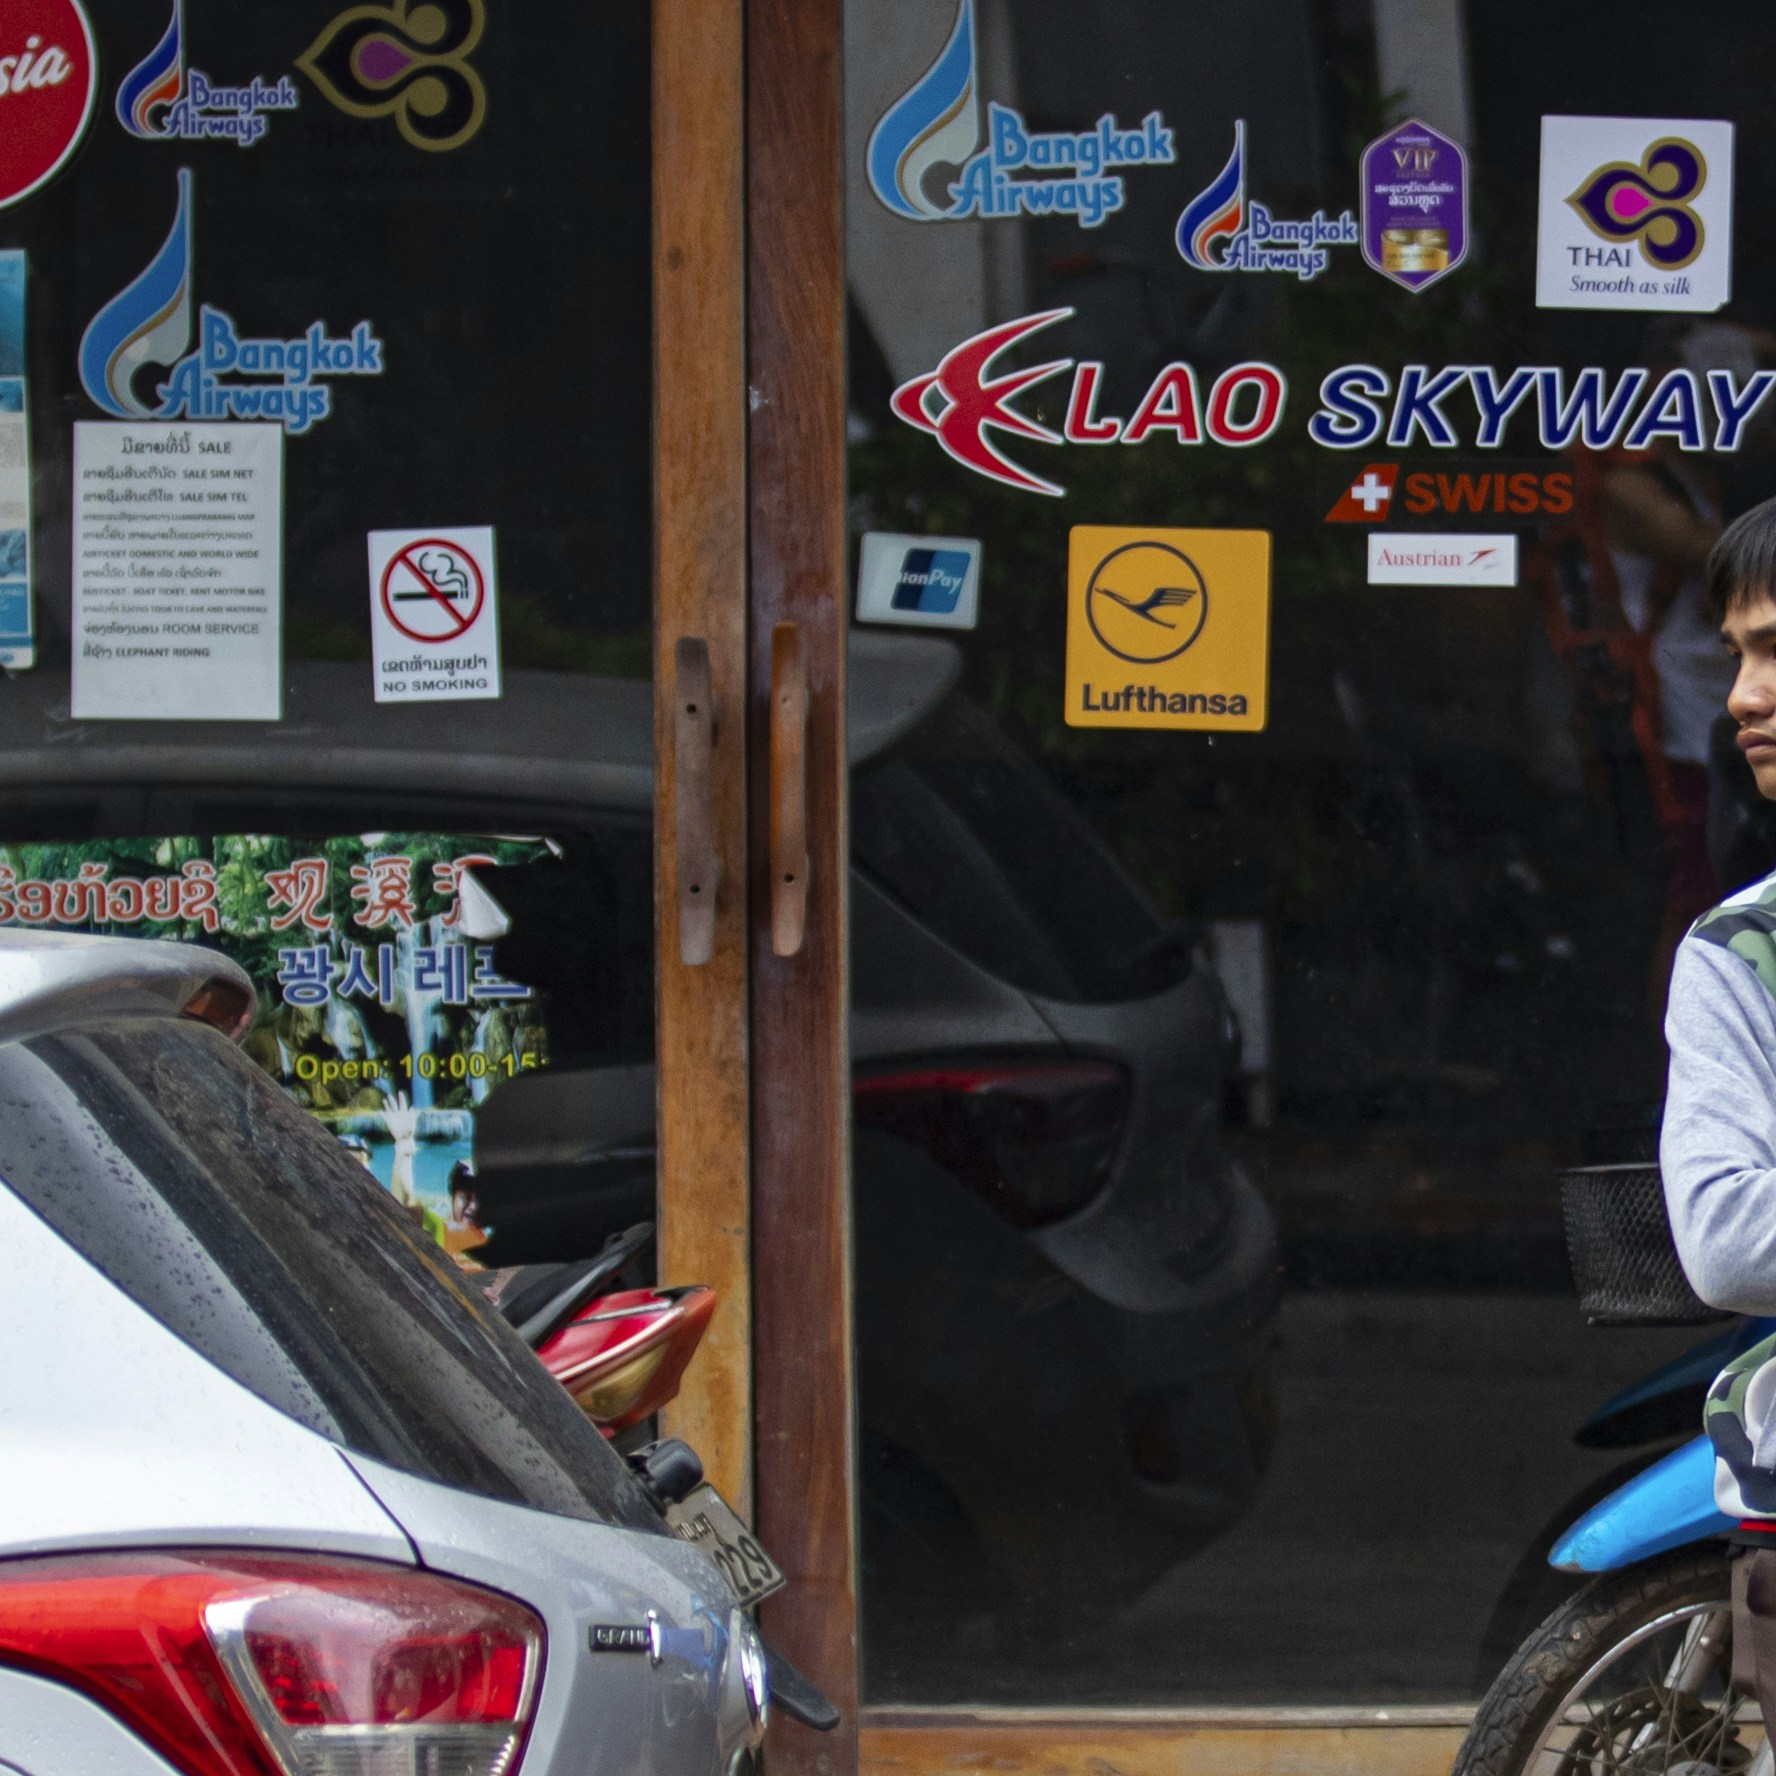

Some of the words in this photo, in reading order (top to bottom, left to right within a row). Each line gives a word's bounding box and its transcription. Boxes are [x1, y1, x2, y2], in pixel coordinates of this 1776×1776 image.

[190, 69, 297, 113] Bangkok
[164, 104, 265, 145] Airways
[989, 103, 1175, 175] Bangkok
[1392, 148, 1437, 170] VIP
[949, 150, 1123, 225] Airways
[1249, 203, 1357, 249] Bangkok
[1222, 235, 1331, 280] Airways
[1567, 246, 1631, 268] THAI
[1570, 275, 1634, 294] Smooth
[1639, 282, 1658, 294] as
[1661, 277, 1691, 295] silk
[203, 307, 382, 381] Bangkok
[159, 355, 328, 433] Airways
[1067, 362, 1287, 446] LAO
[198, 442, 232, 455] SALE
[182, 469, 207, 480] SALE
[209, 469, 231, 480] SIM
[233, 469, 254, 480] NET
[179, 492, 204, 503] SALE
[206, 492, 227, 503] SIM
[230, 492, 249, 503] TEL
[1404, 472, 1574, 515] SWISS
[177, 550, 198, 559] AND
[200, 550, 233, 559] WORLD
[235, 550, 259, 559] WIDE
[1376, 546, 1462, 570] Austrian
[162, 624, 201, 635] ROOM
[204, 624, 259, 635] SERVICE
[115, 647, 170, 658] ELEPHANT
[172, 647, 210, 658] RIDING
[383, 681, 407, 693] NO
[411, 678, 488, 692] SMOKING
[1080, 683, 1248, 718] Lufthansa
[277, 943, 394, 1006] 꽝시
[296, 1054, 390, 1084] Open:
